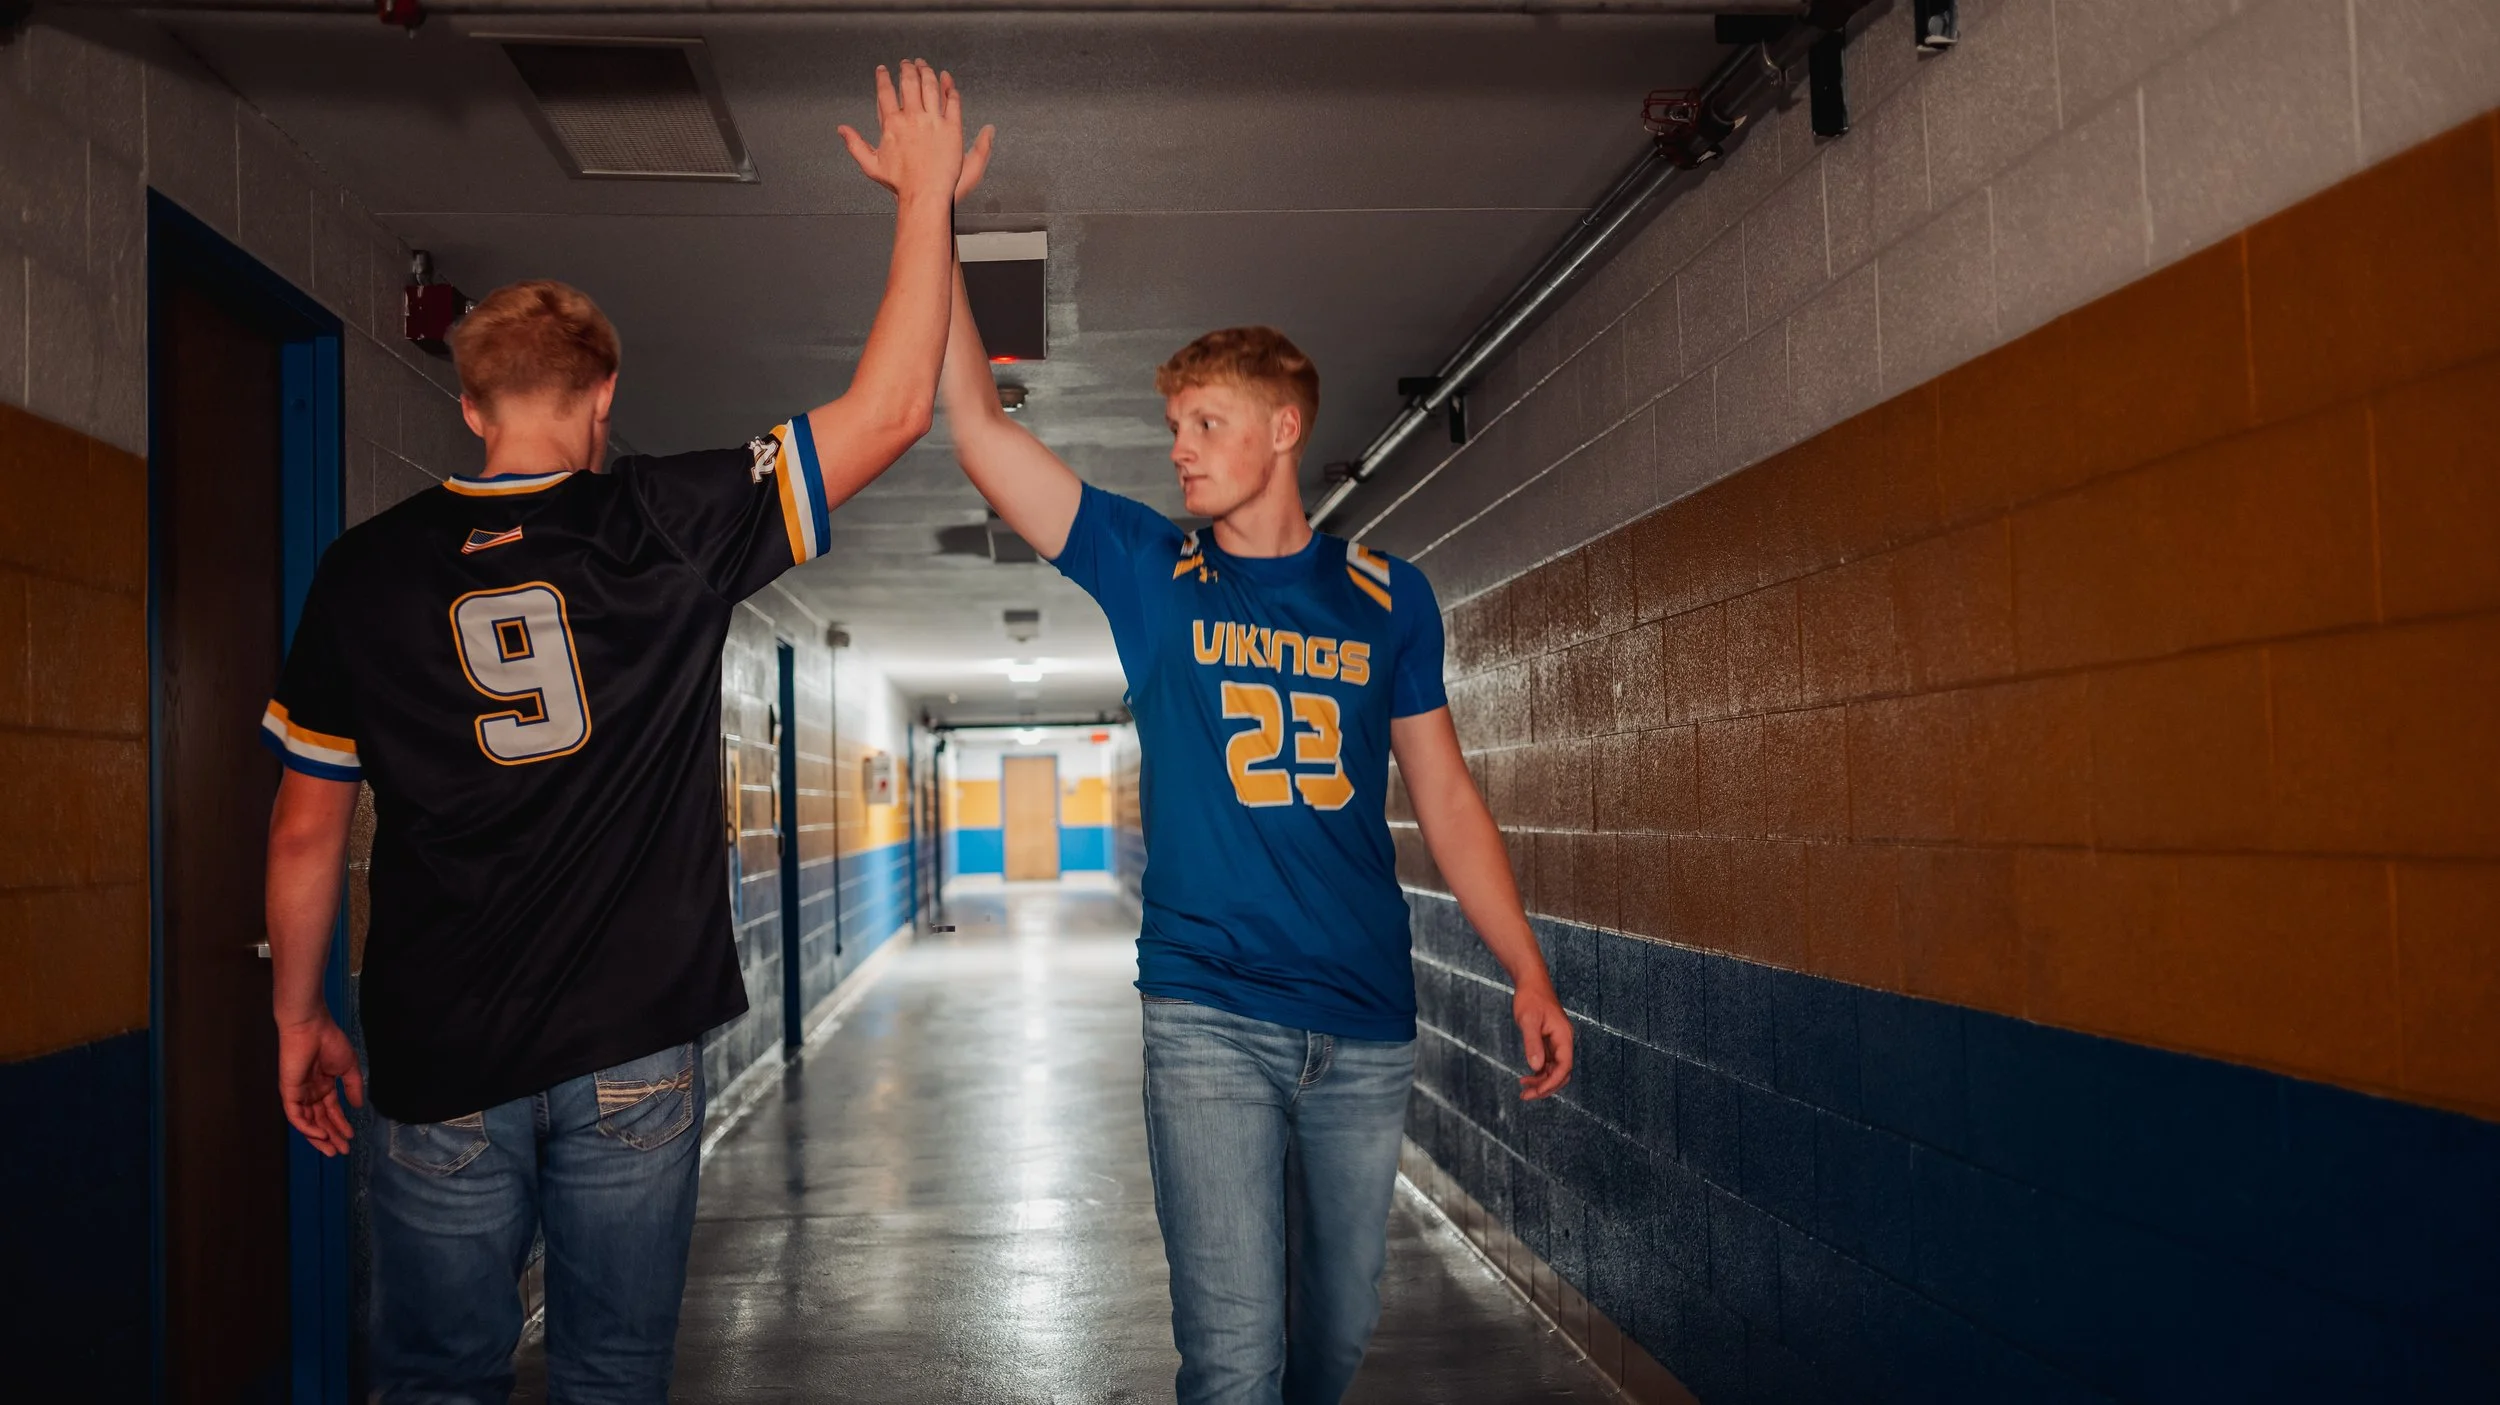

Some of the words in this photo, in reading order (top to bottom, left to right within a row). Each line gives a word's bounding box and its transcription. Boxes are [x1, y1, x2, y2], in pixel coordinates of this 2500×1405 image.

[449, 580, 592, 766] 9
[1193, 619, 1371, 686] VIKINGS
[1220, 680, 1355, 811] 23
